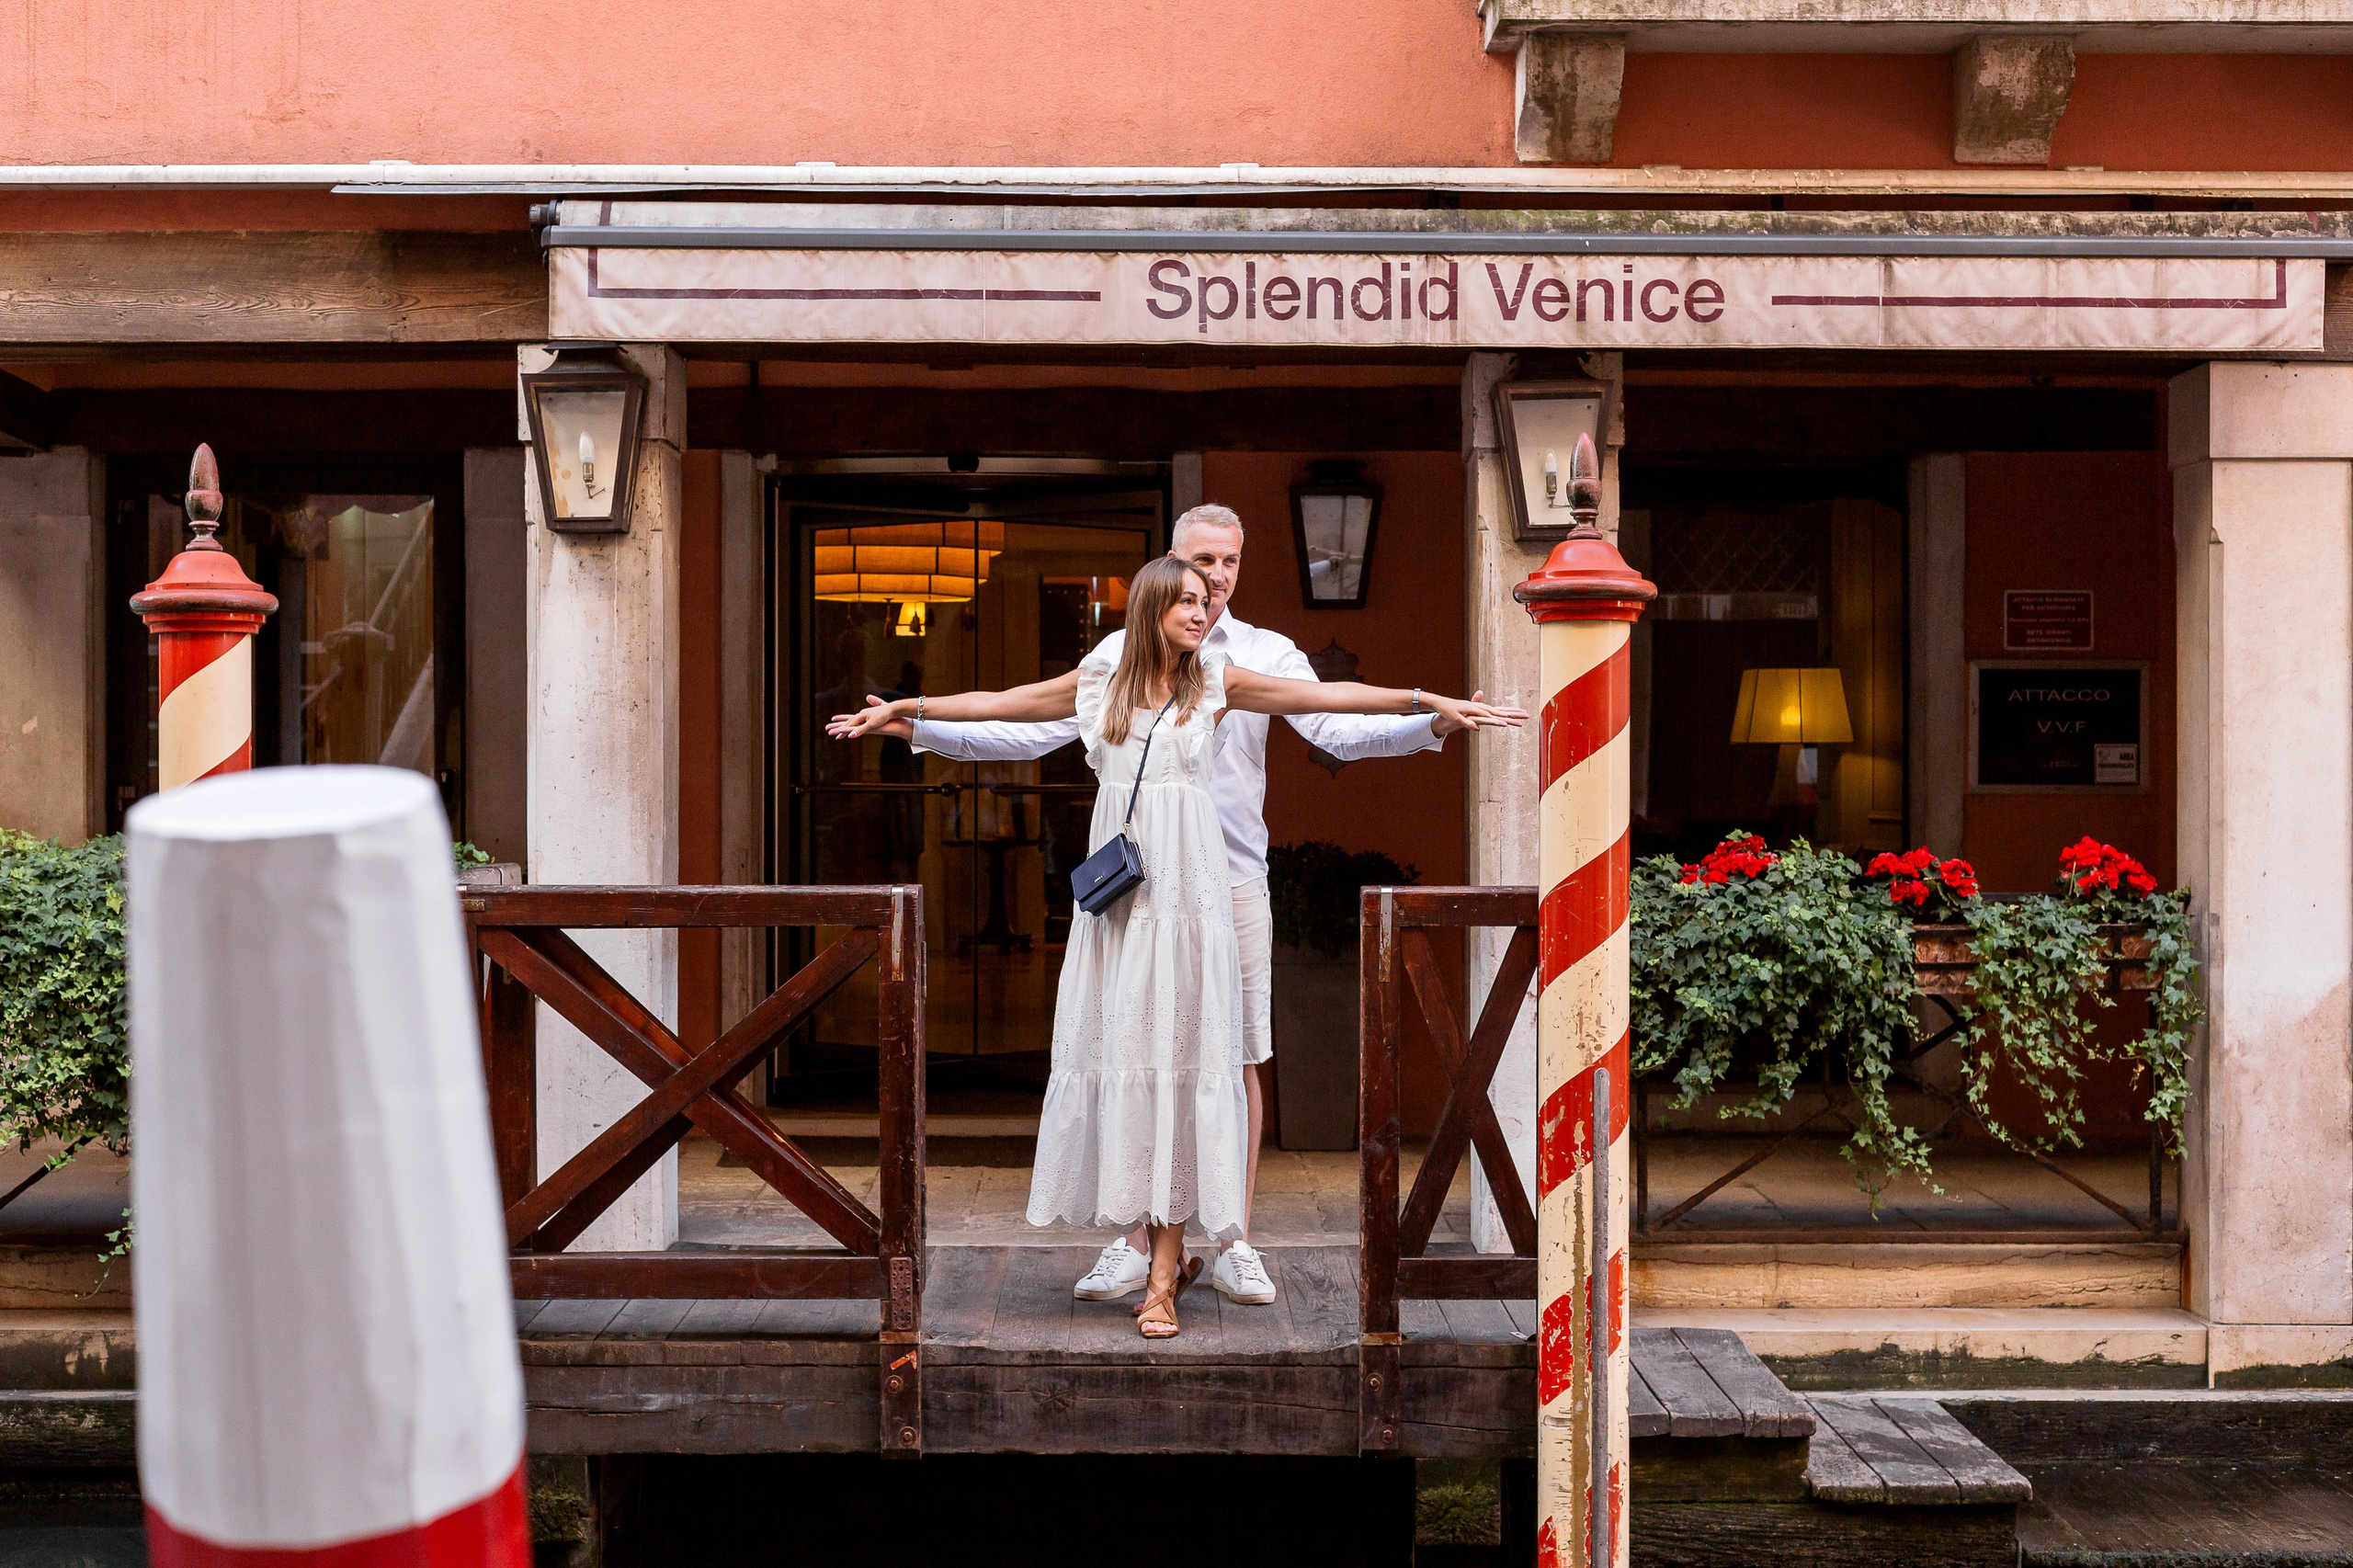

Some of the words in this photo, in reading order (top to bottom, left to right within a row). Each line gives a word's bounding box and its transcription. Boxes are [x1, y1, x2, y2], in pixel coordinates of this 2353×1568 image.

[1146, 259, 1459, 333] Splendid
[1484, 262, 1725, 323] Venice
[2008, 689, 2110, 702] ATTACCO
